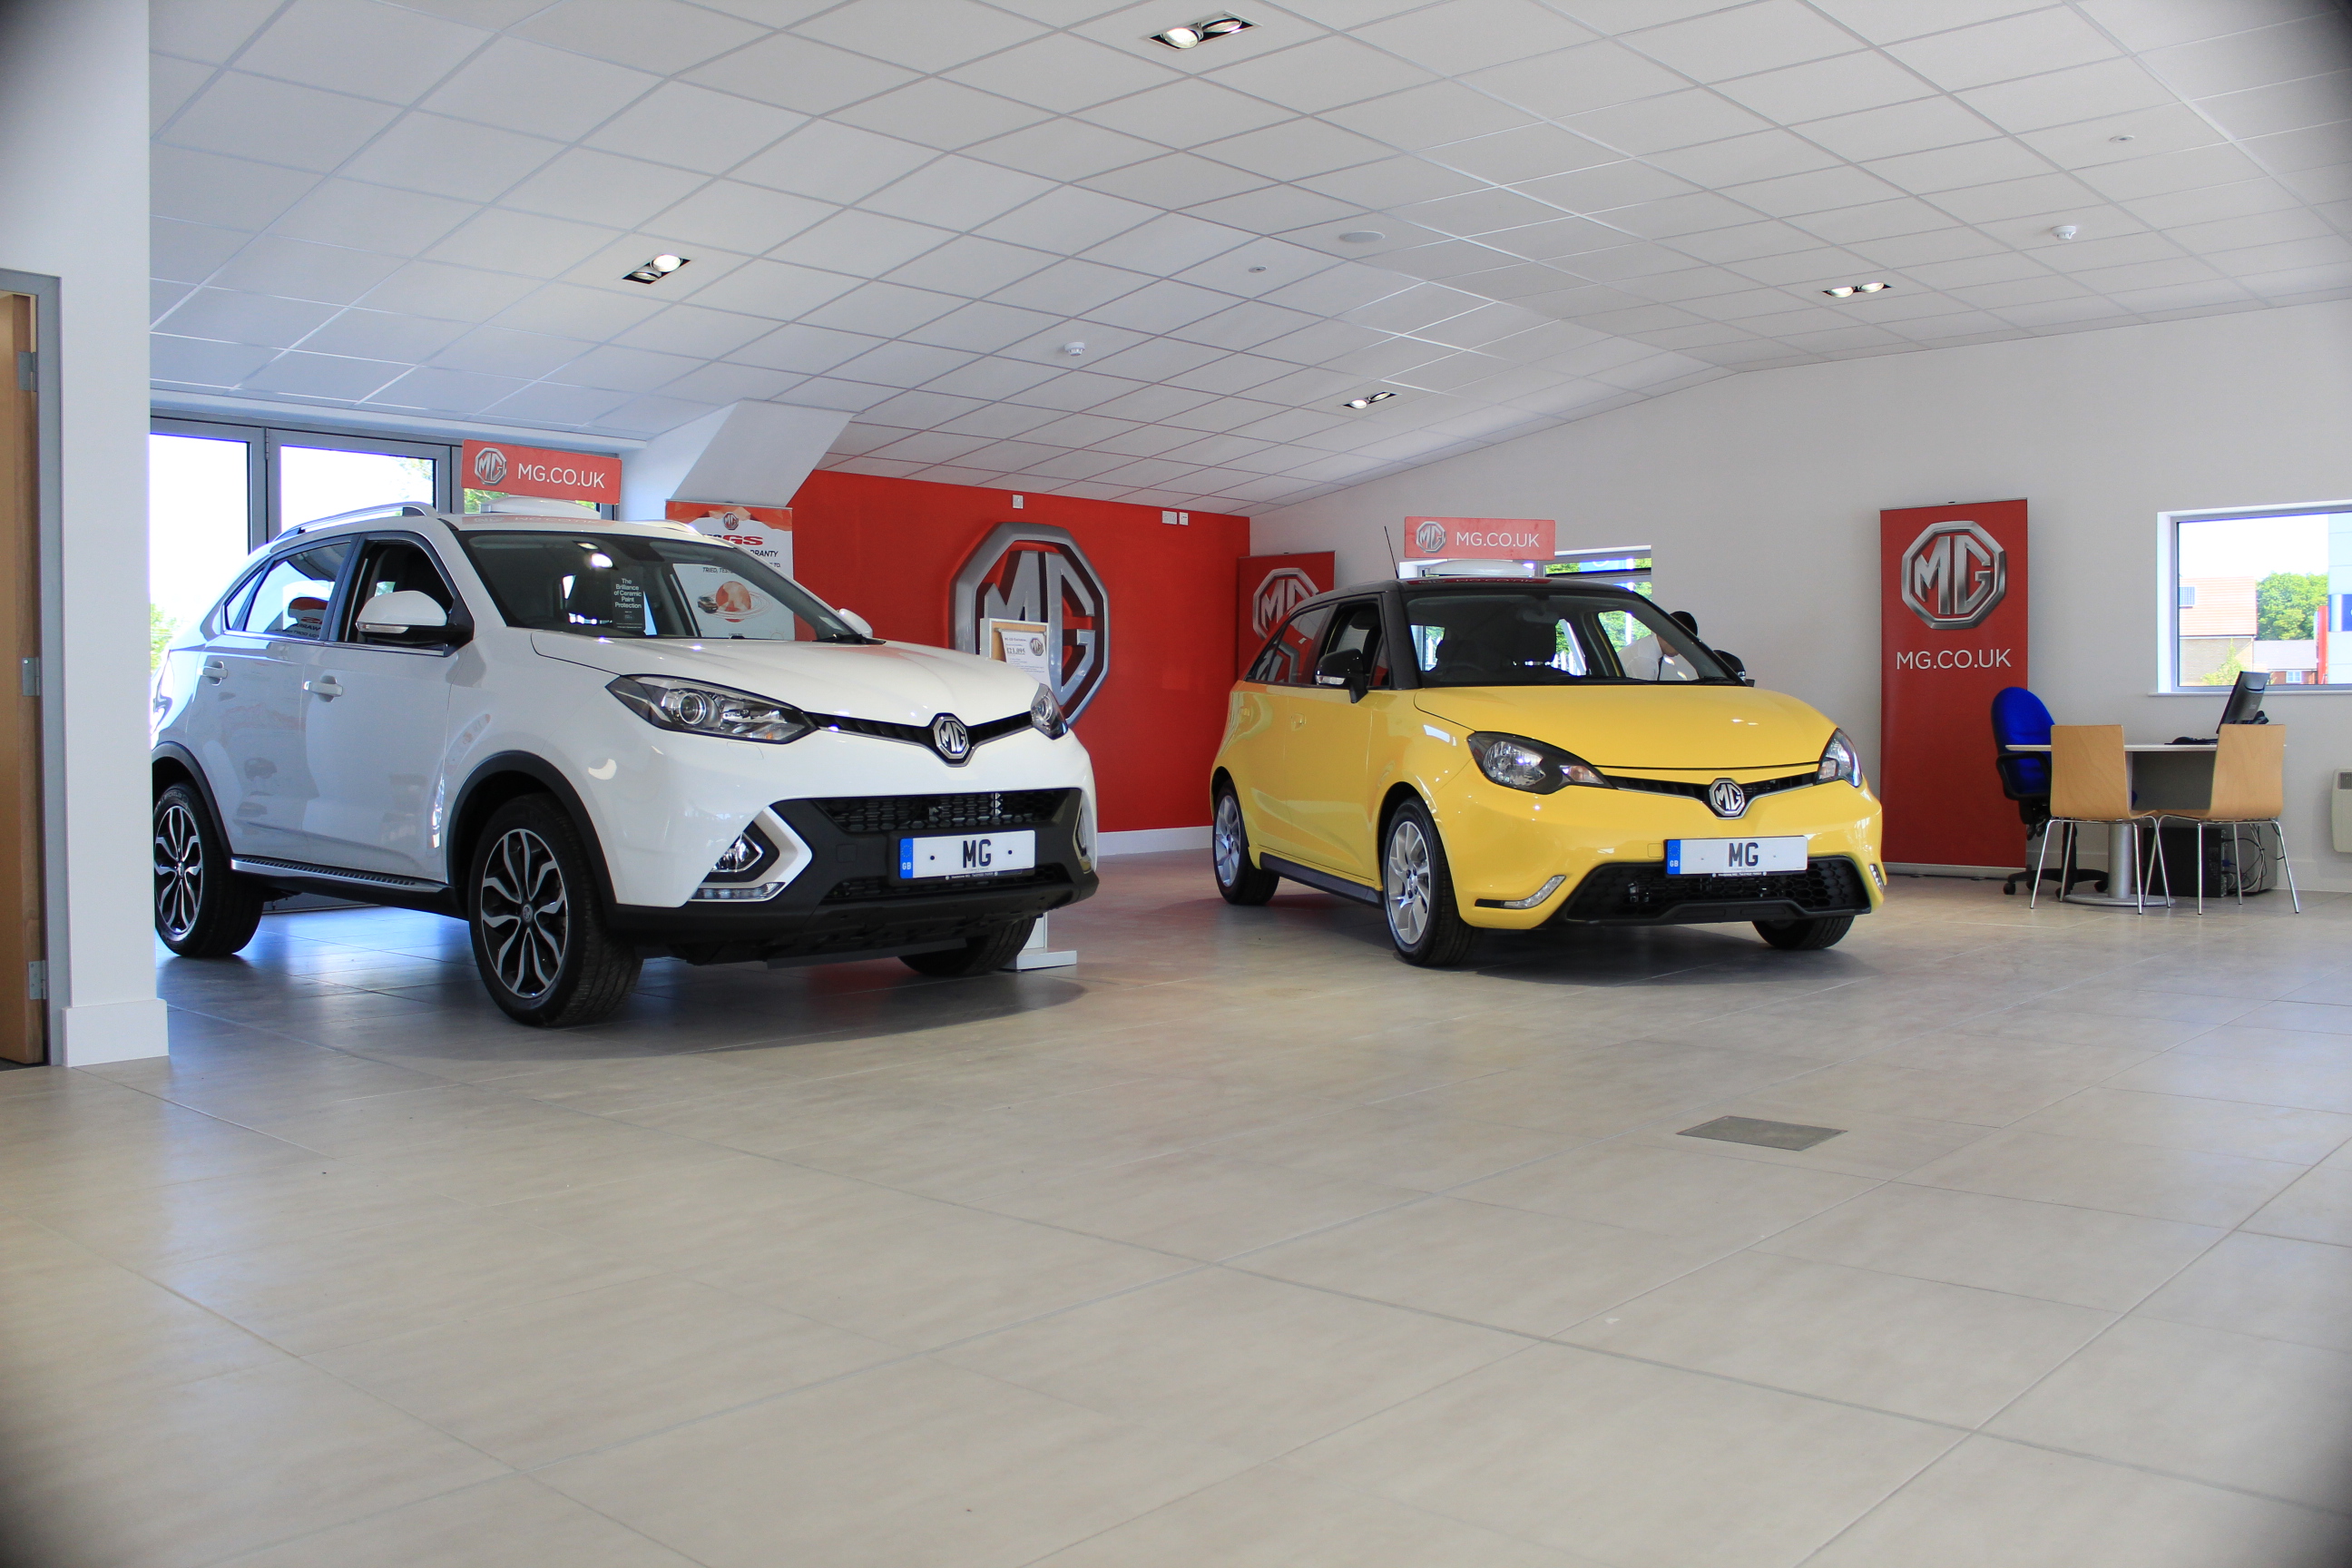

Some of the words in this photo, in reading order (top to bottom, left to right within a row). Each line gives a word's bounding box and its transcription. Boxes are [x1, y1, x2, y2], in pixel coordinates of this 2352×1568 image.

[517, 463, 605, 489] MG.CO.UK
[1455, 531, 1540, 548] MG.CO.UK
[1914, 534, 1993, 615] MG
[1896, 648, 2012, 670] MG.CO.UK
[939, 720, 966, 753] MG
[1714, 783, 1742, 811] MG
[902, 861, 912, 870] GB
[962, 838, 992, 869] MG
[1669, 859, 1679, 867] GB
[1728, 841, 1759, 867] MG
